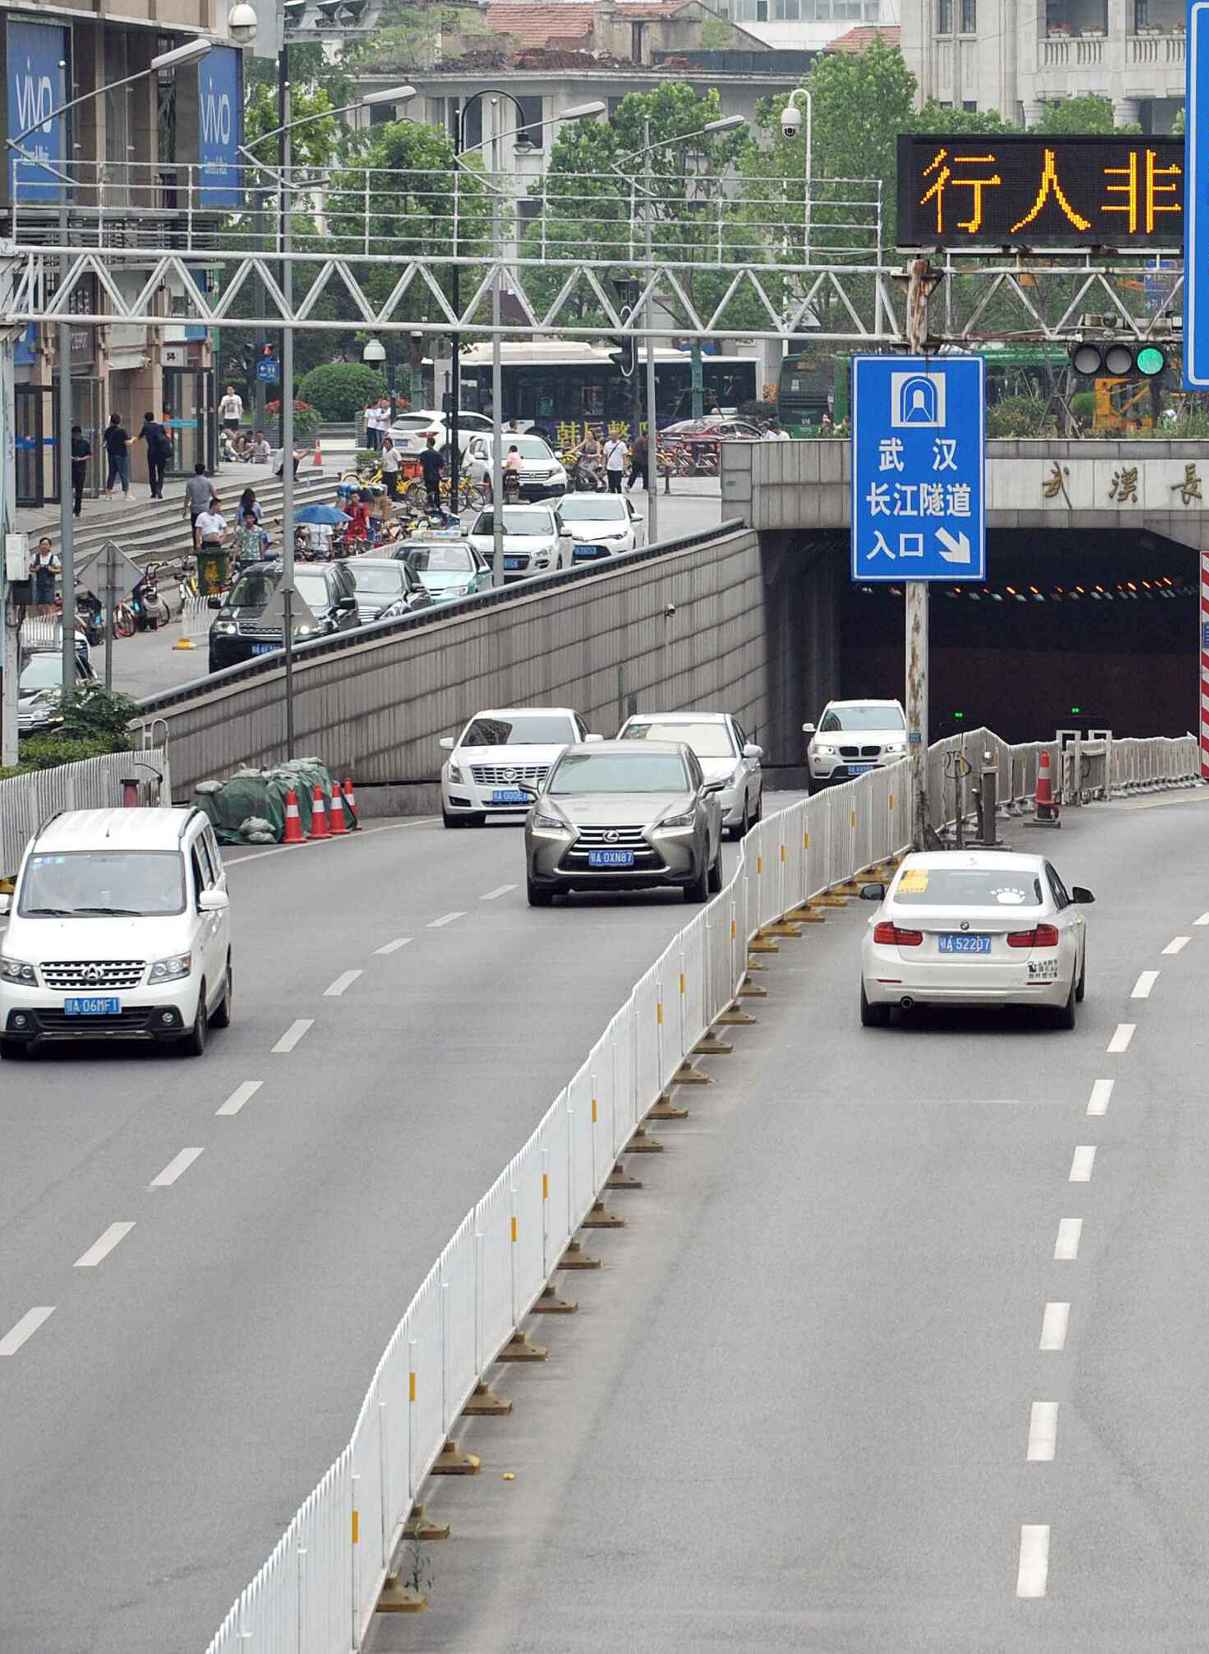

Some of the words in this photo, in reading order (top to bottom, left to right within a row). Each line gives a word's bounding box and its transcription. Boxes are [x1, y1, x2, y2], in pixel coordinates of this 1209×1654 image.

[200, 77, 231, 144] vivo
[921, 148, 1182, 234] 行人非
[879, 437, 958, 472] 武汉
[866, 482, 972, 517] 长江隧道
[866, 530, 924, 560] 入口
